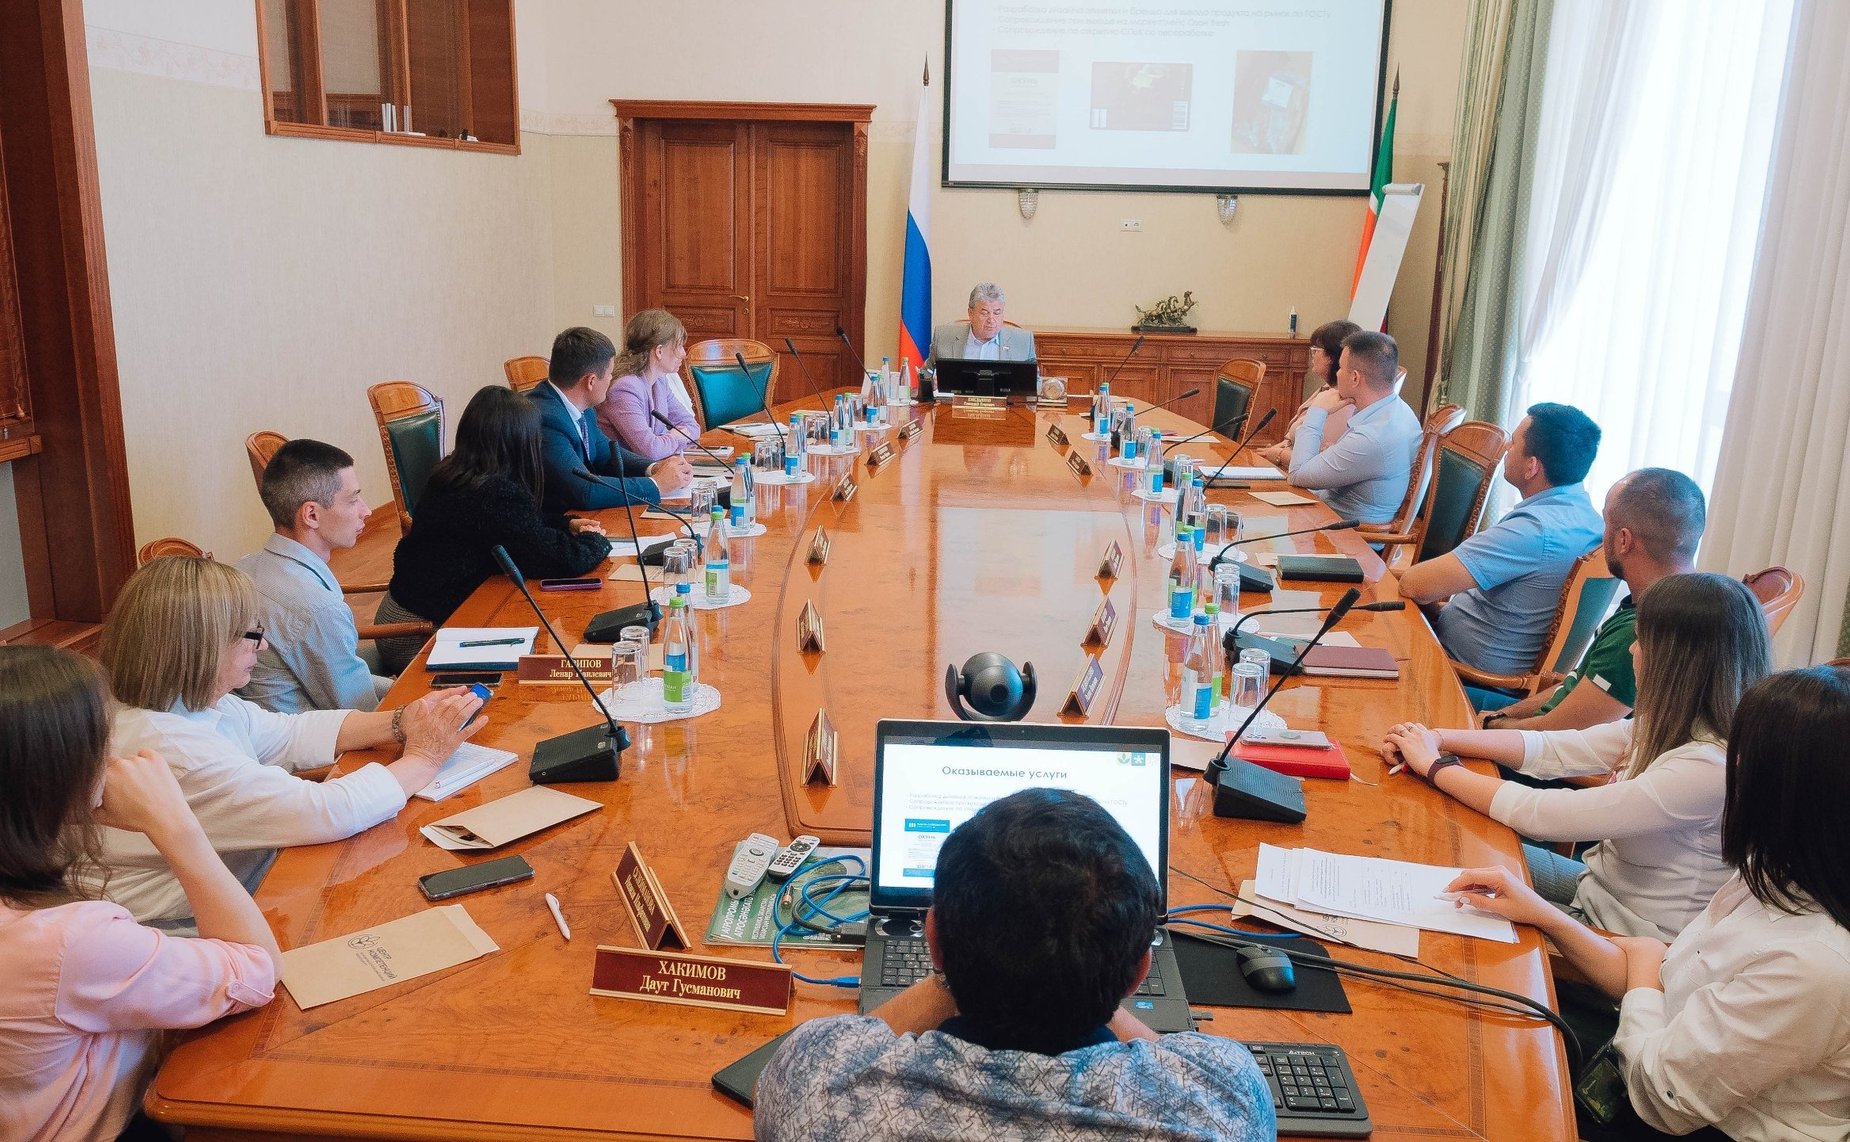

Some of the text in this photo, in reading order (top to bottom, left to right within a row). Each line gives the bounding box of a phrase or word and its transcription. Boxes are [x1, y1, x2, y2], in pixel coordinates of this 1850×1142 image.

[561, 659, 602, 668] ГАИПОВ
[550, 669, 574, 680] Ленар
[942, 766, 1067, 780] Оказываемые услуги
[658, 960, 727, 981] ХАКИМОВ
[640, 974, 741, 999] Даут Гусманович
